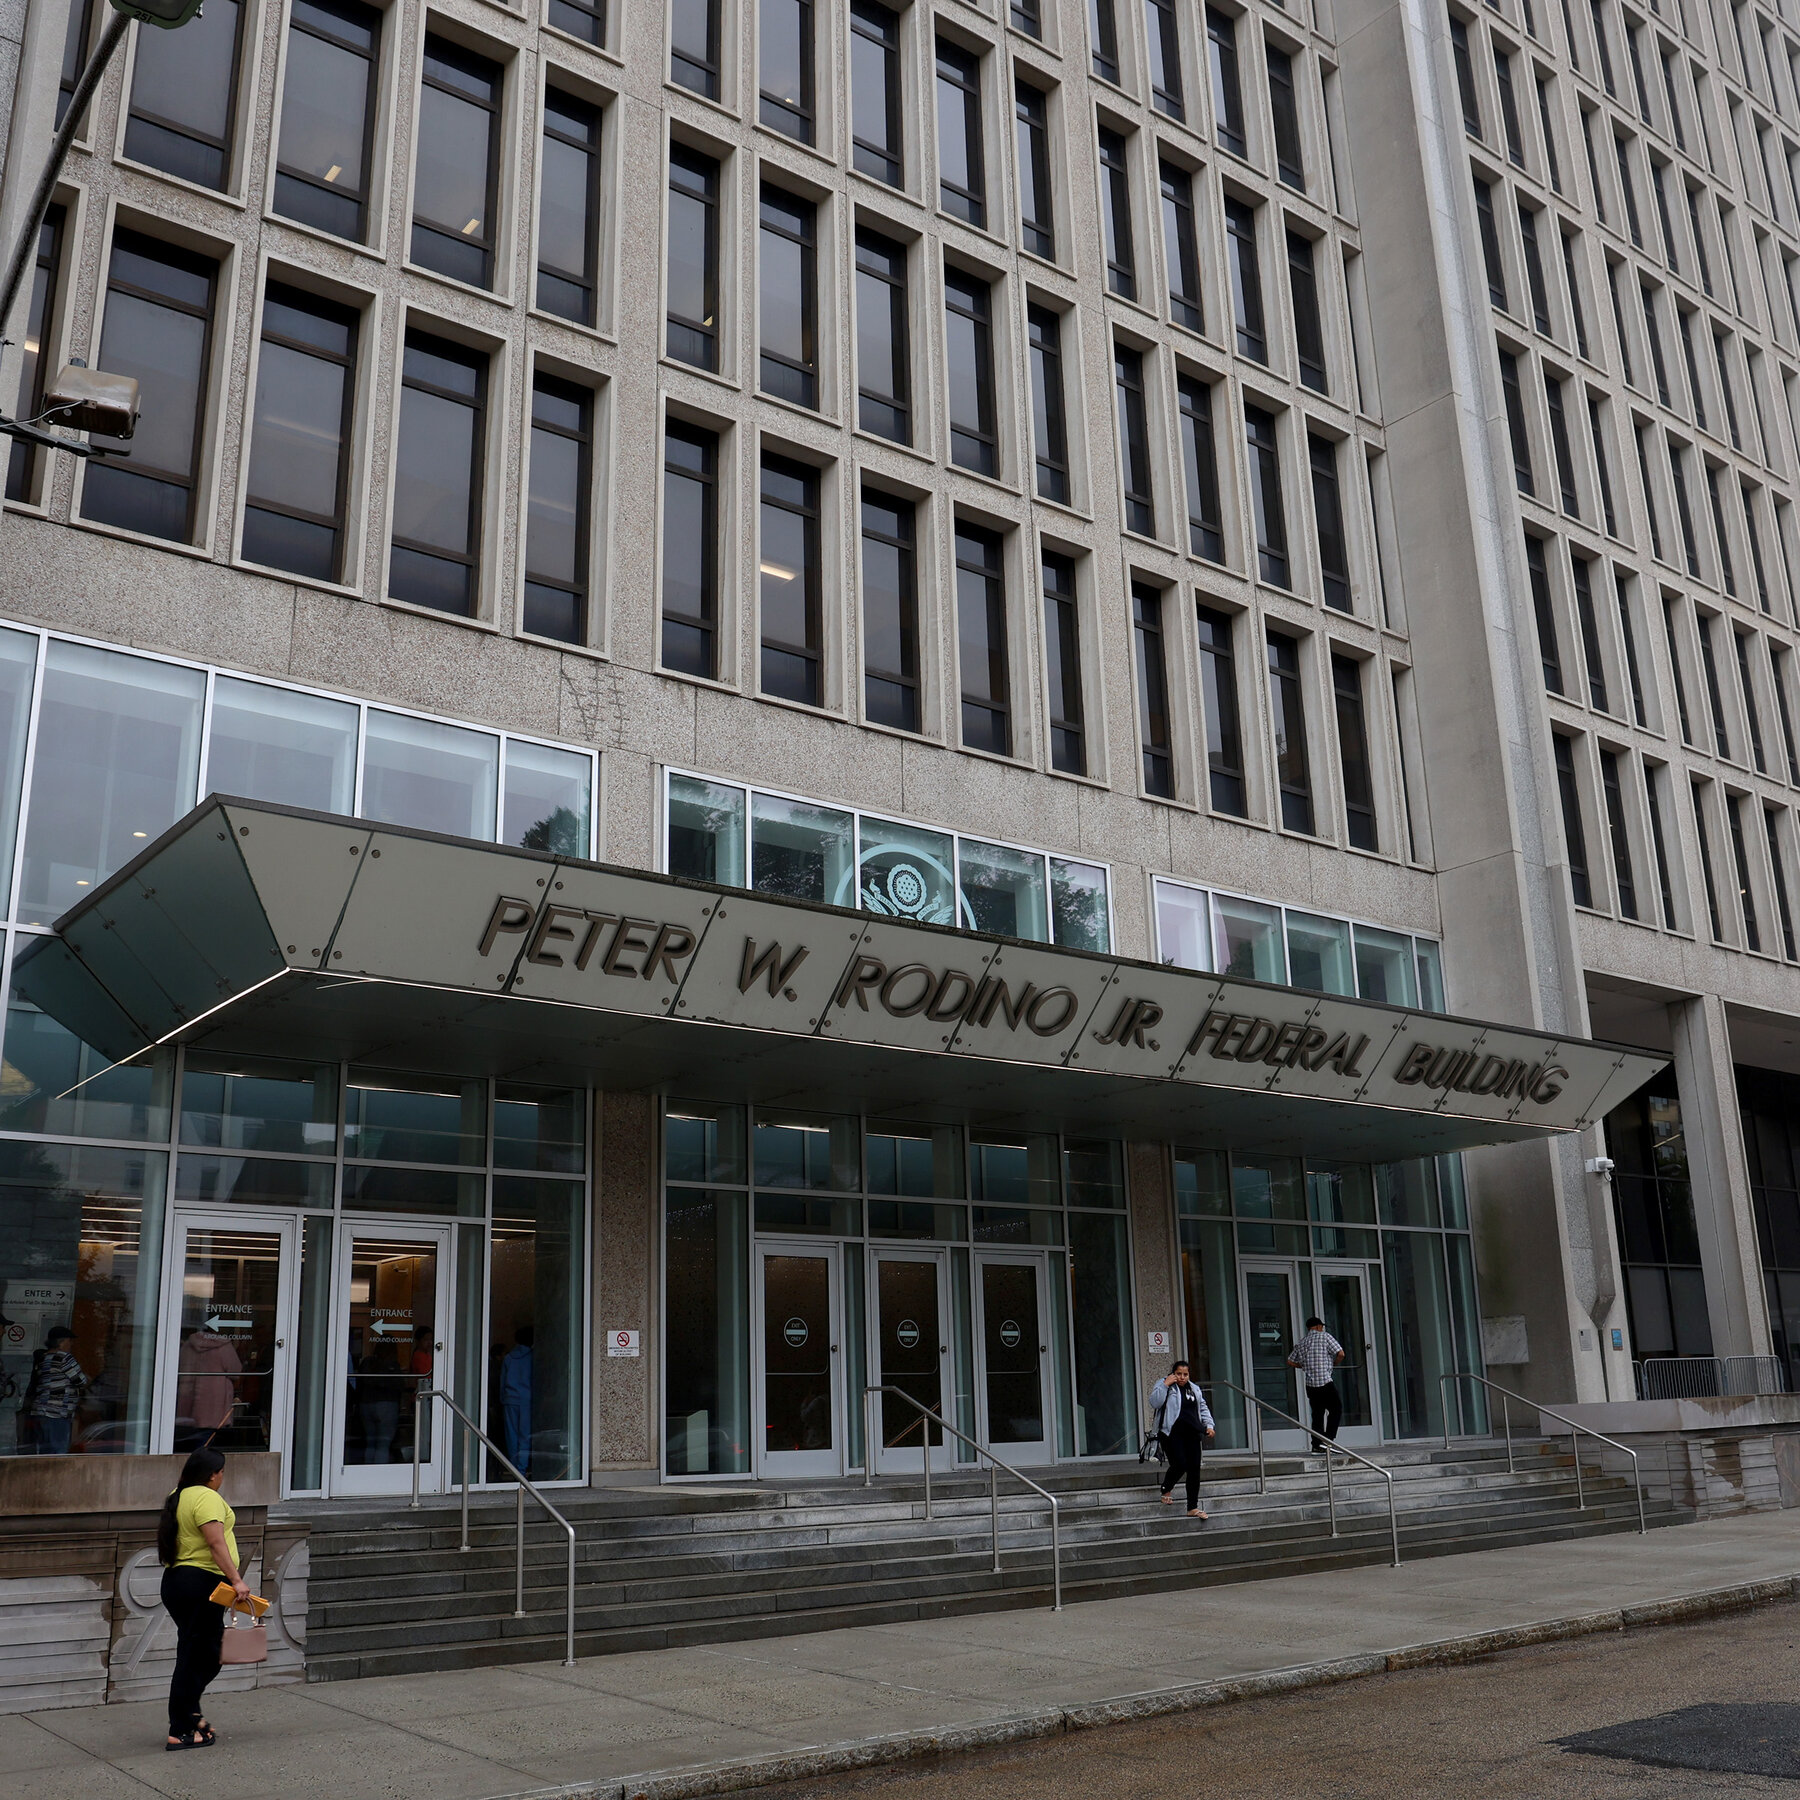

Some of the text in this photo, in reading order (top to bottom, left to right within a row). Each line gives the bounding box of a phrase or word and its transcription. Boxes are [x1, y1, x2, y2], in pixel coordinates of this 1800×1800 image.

[478, 896, 1569, 1105] PETER W. RODINO JR. FEDERAL BUILDING
[24, 1289, 52, 1298] ENTER
[205, 1303, 253, 1314] ENTRANCE
[370, 1308, 413, 1318] ENTRANCE
[1258, 1321, 1280, 1329] ENTRANCE
